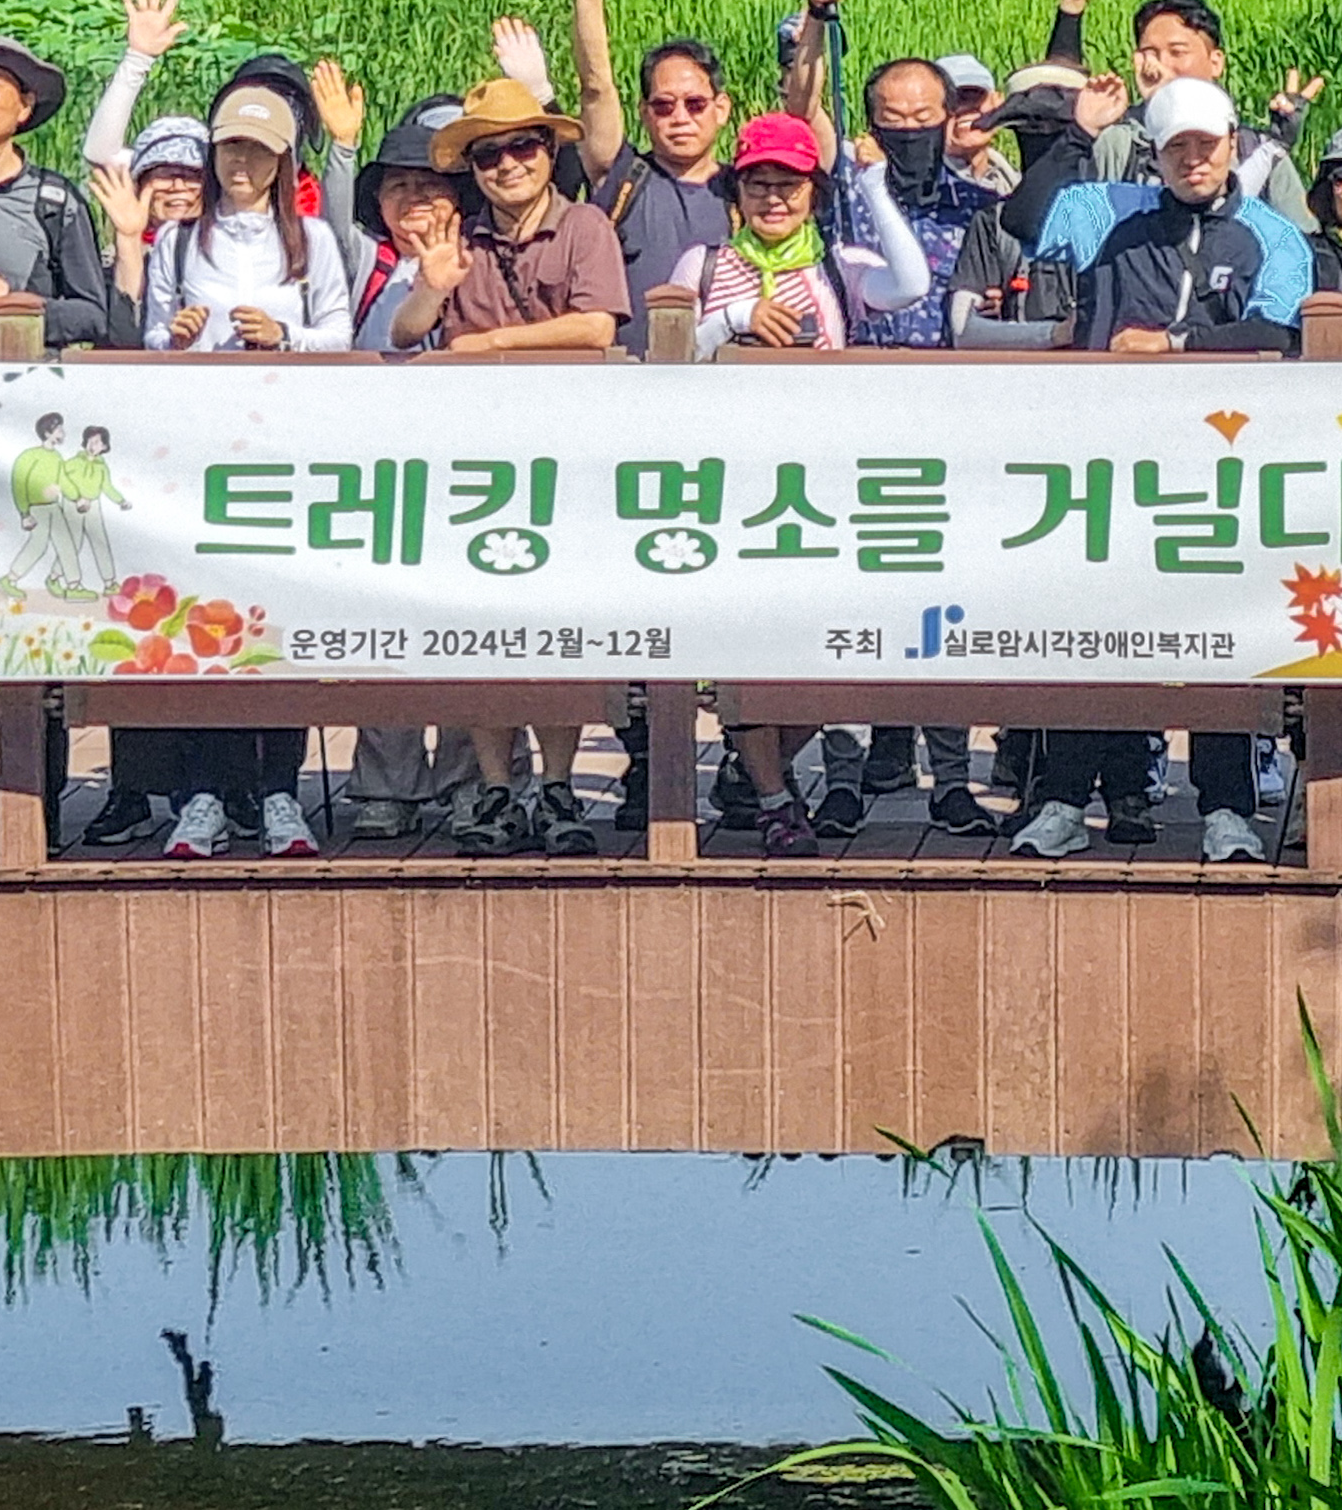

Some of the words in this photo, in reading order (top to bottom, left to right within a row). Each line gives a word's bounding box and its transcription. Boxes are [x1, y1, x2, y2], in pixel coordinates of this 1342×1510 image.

[194, 457, 558, 575] 트레킹
[615, 457, 951, 575] 명소를
[289, 628, 409, 661] 운영기간
[422, 627, 527, 660] 2024년
[536, 627, 672, 661] 2월~12월
[825, 628, 883, 661] 주최
[943, 629, 1236, 660] 실로암시각장애인복지관
